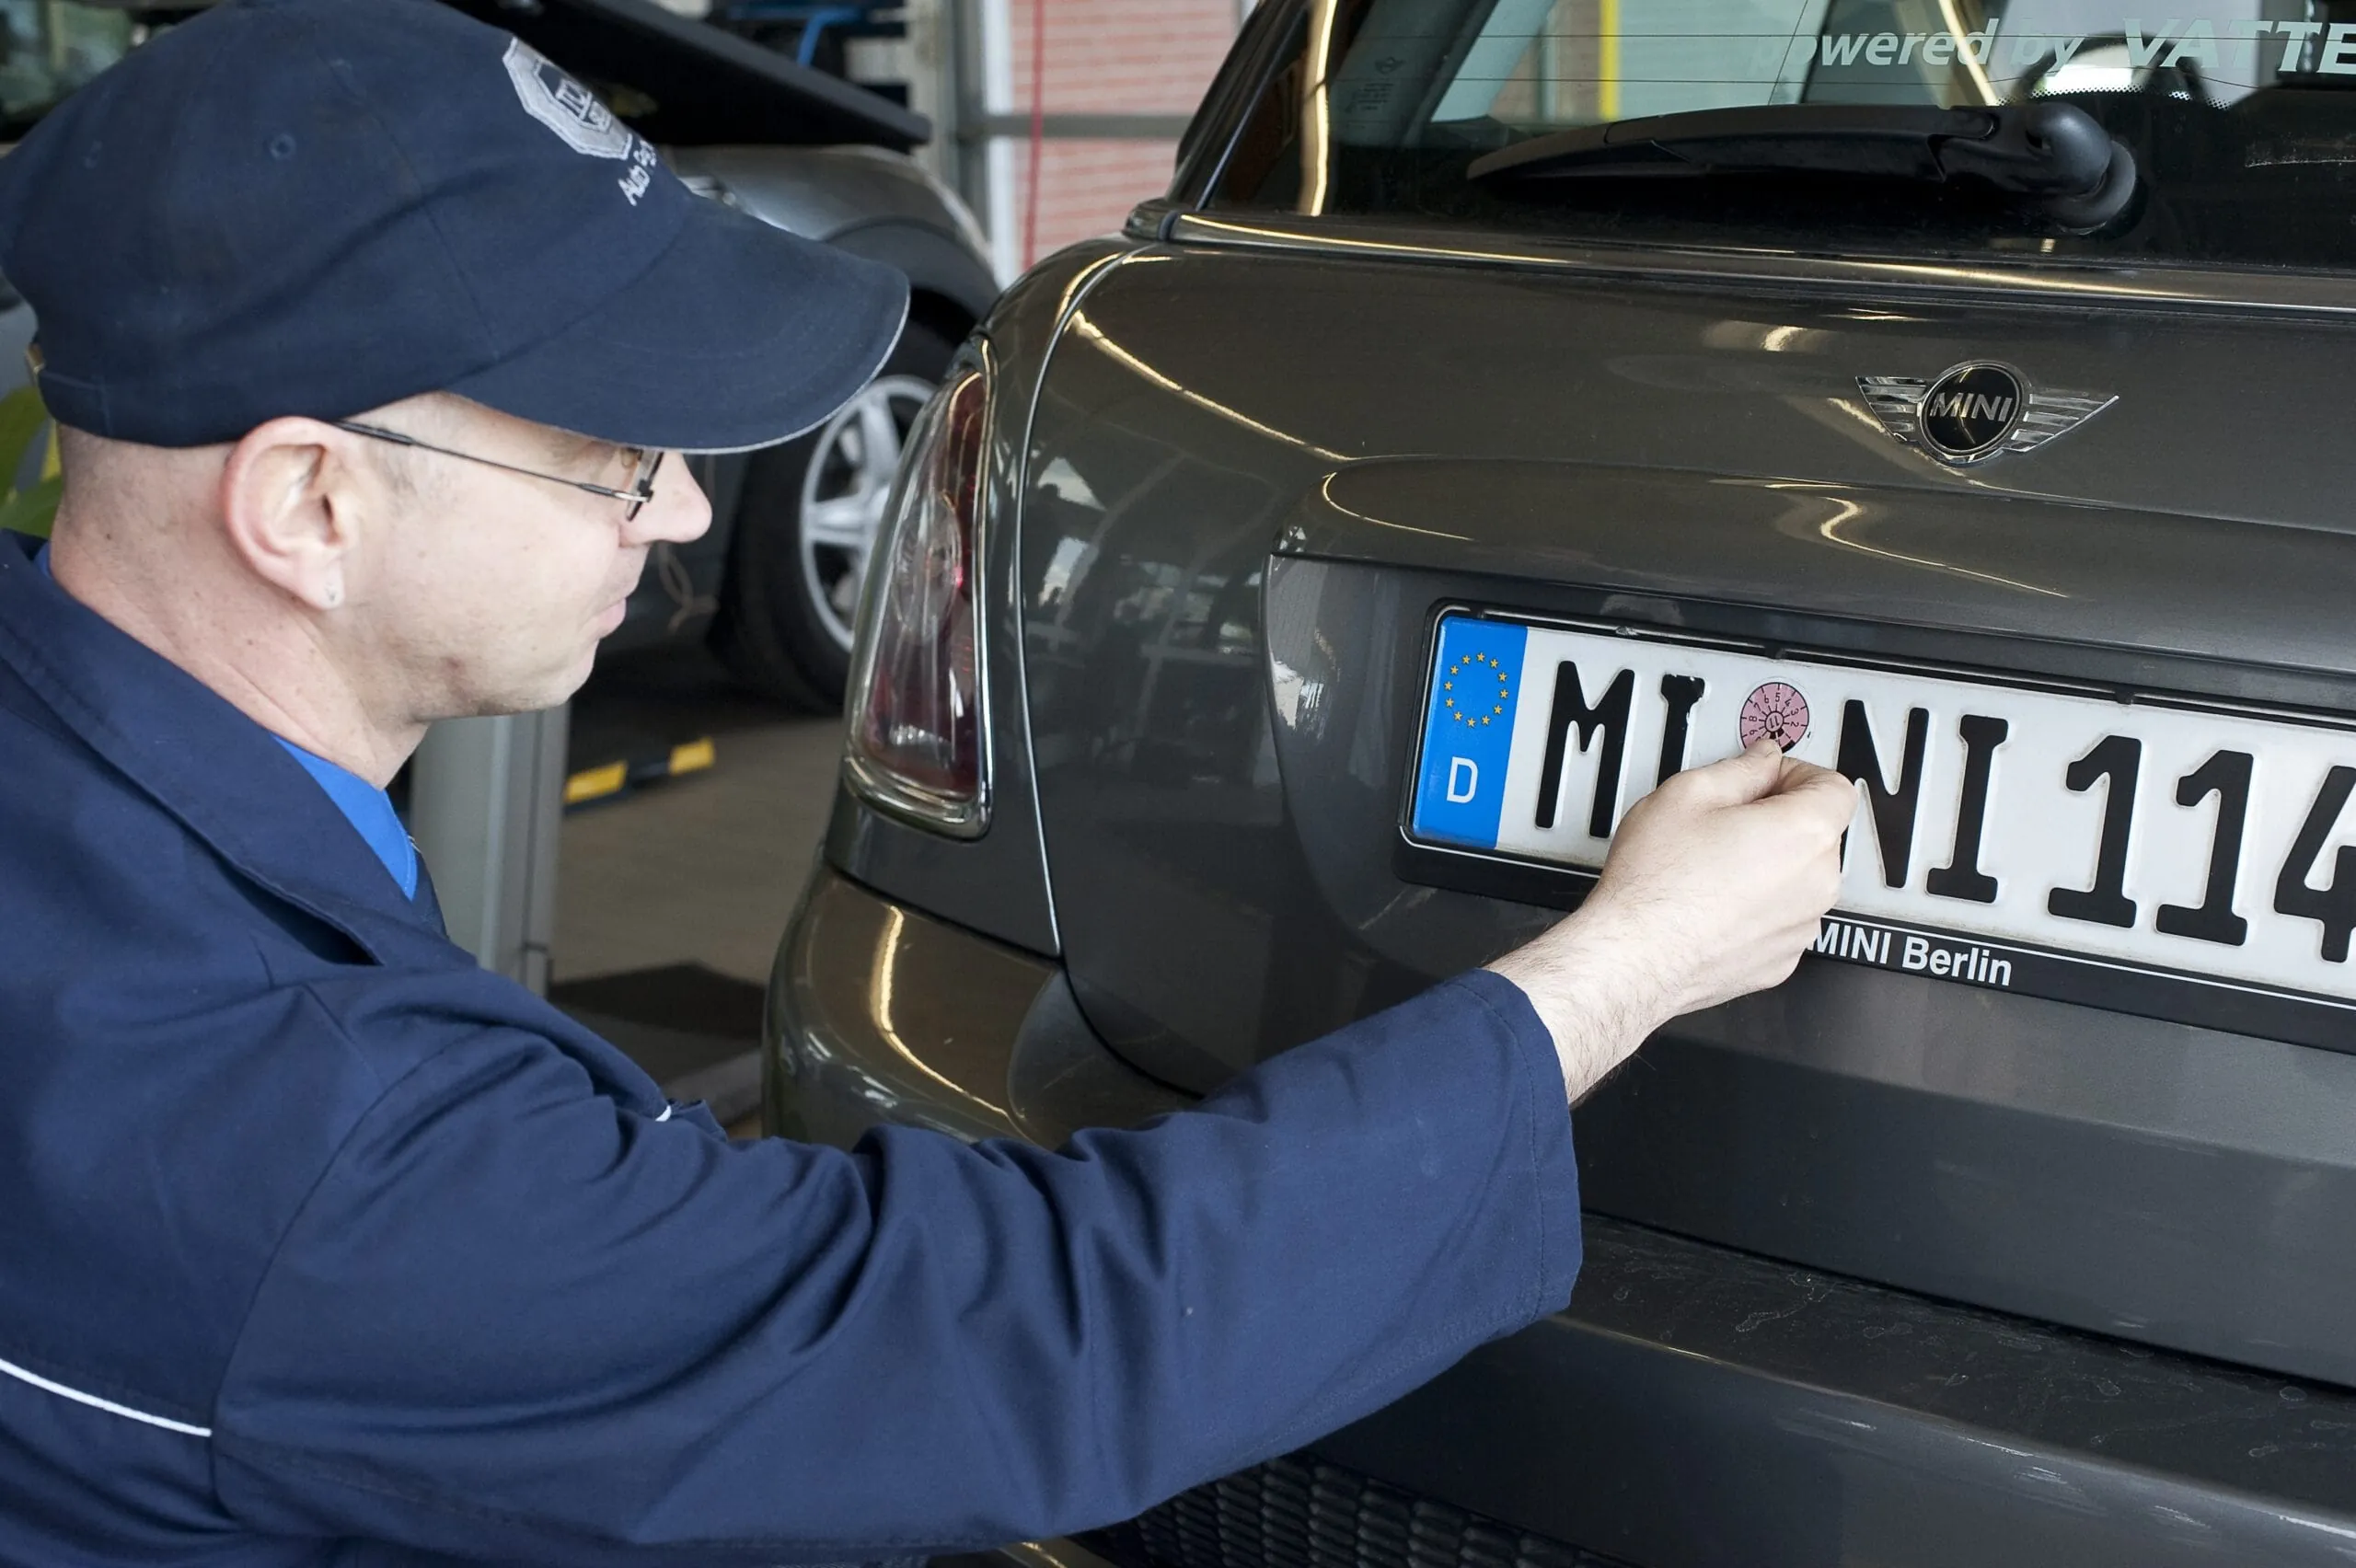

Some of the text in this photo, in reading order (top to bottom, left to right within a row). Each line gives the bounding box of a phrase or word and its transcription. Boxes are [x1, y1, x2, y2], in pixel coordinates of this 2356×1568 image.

[2010, 19, 2084, 76] by
[1930, 392, 2013, 421] MINI
[1446, 756, 1478, 803] D
[1837, 699, 2009, 904] NI
[2048, 734, 2356, 963] 114
[1807, 922, 2013, 986] MINI Berlin
